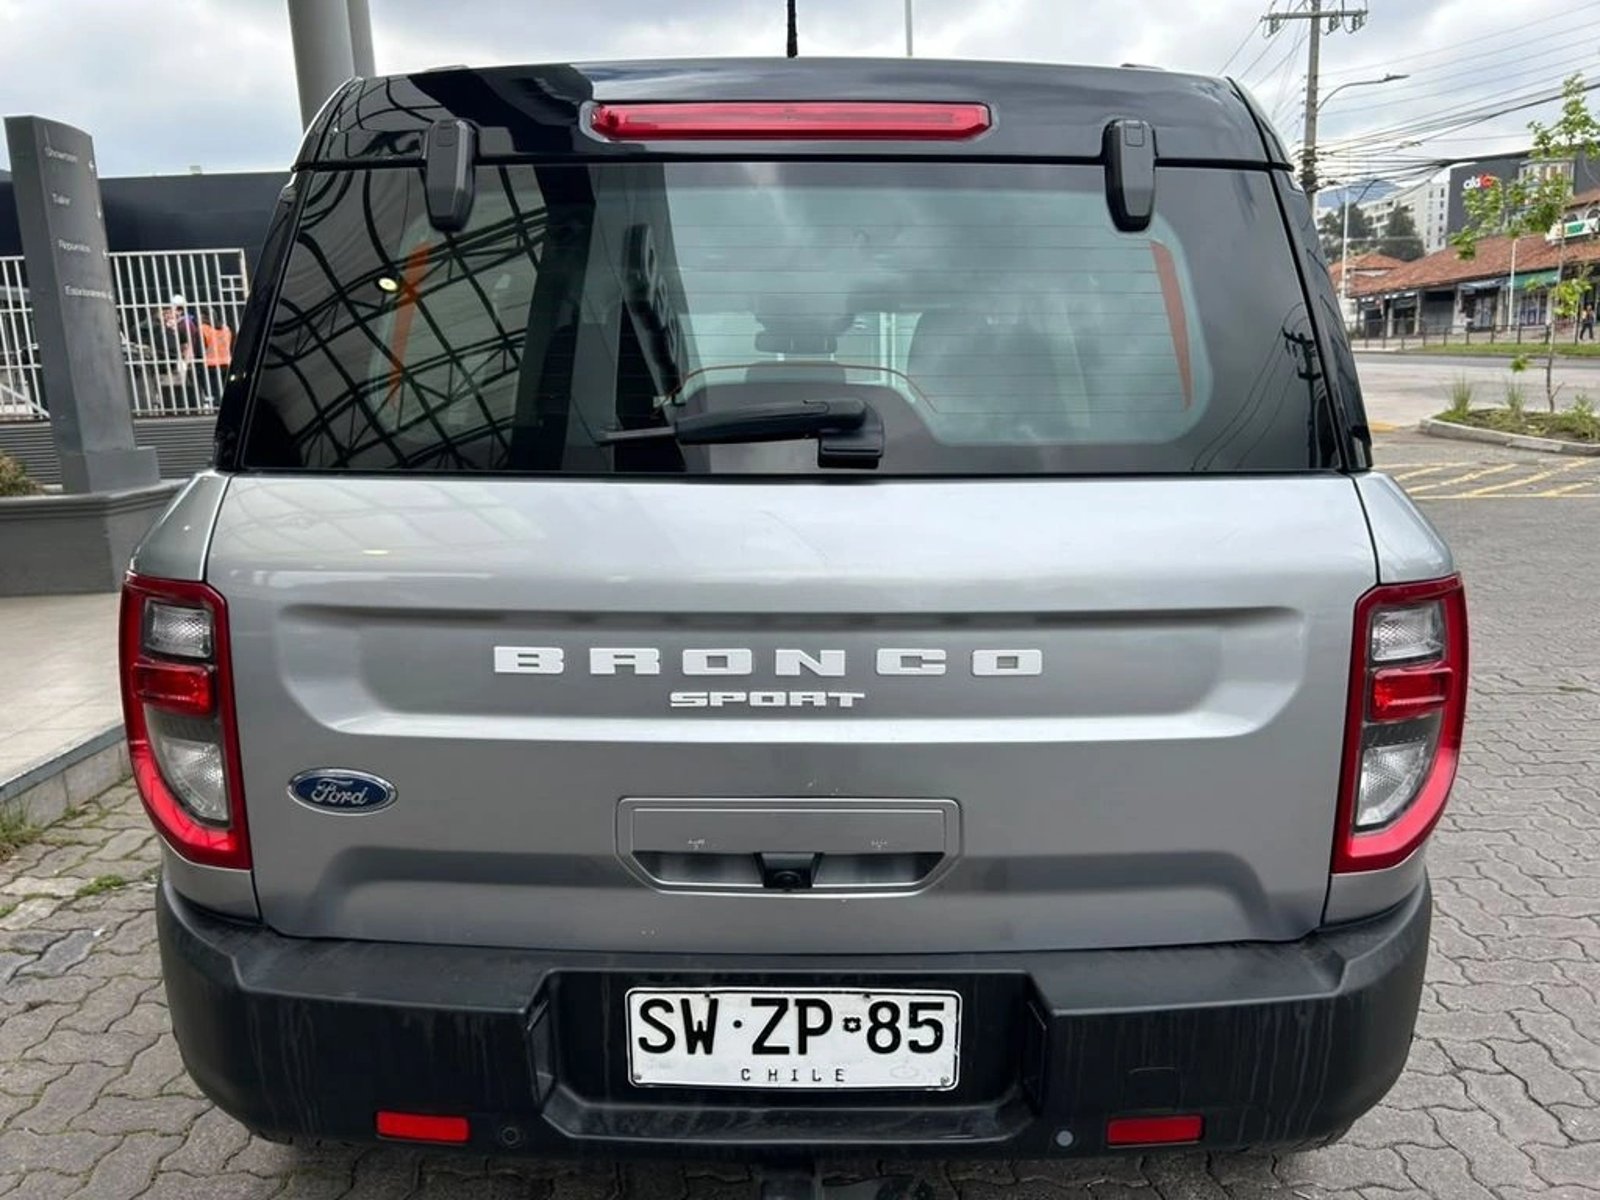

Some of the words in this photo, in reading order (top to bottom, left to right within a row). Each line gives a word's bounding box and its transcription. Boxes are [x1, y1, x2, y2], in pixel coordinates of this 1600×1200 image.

[494, 646, 1043, 677] BRONCO
[670, 690, 866, 708] SPORT
[311, 774, 369, 805] Ford
[741, 1068, 845, 1082] CHILE
